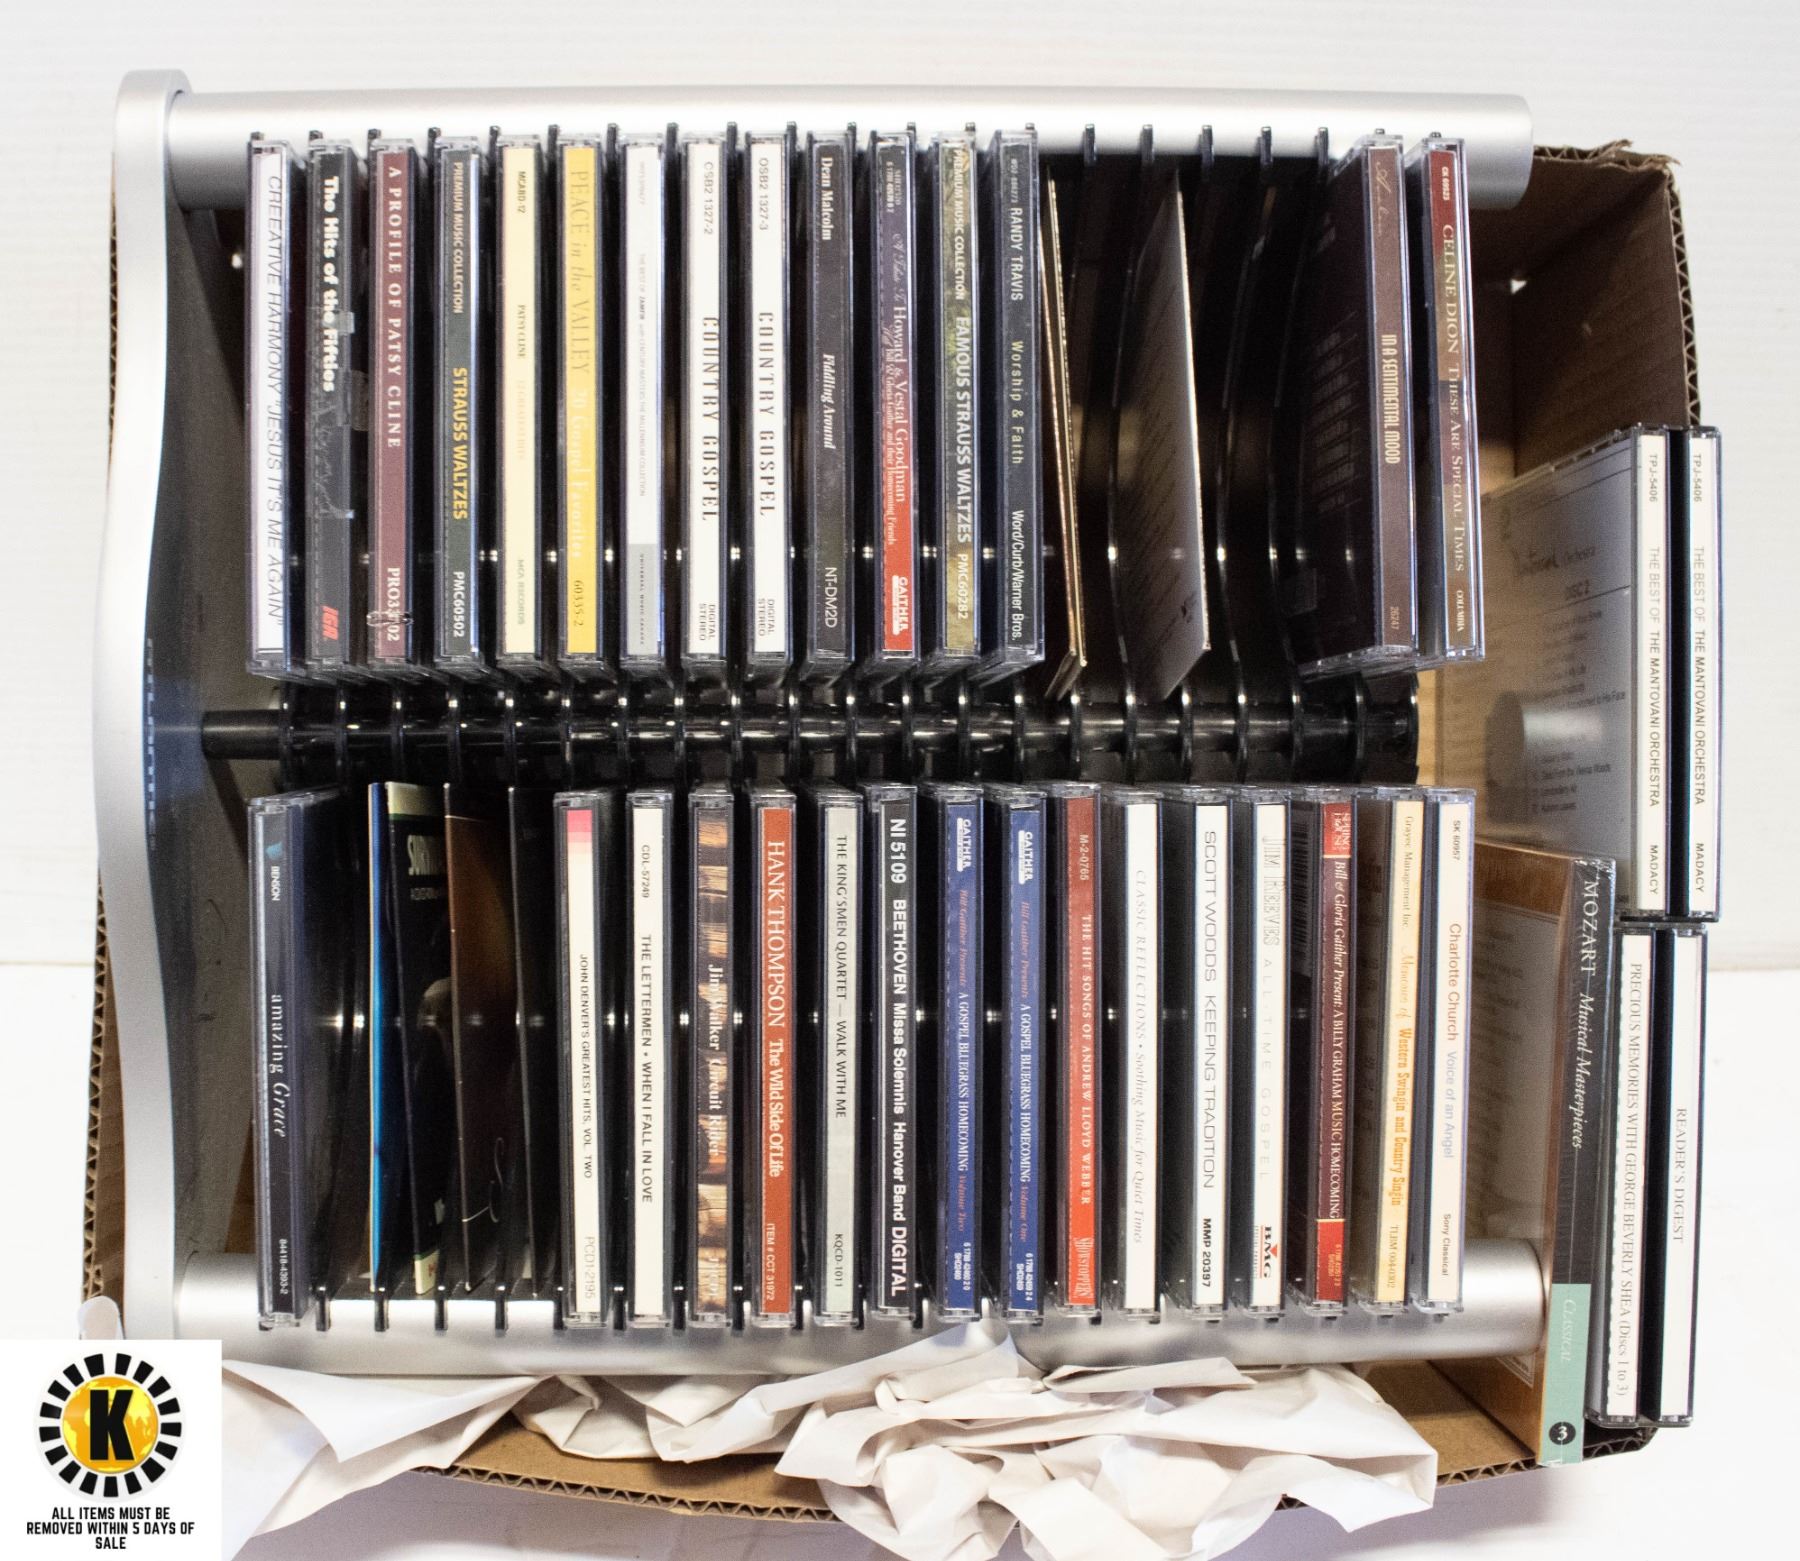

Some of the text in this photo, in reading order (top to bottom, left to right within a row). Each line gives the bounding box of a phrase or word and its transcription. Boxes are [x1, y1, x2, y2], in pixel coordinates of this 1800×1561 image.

[821, 157, 834, 240] Dean Malcolm
[954, 150, 965, 299] PREMIUM MUSIC COLLECTION
[1010, 207, 1022, 250] RANDY
[453, 162, 464, 313] PREMIUM MUSIC COLLECTION
[570, 171, 592, 374] PEACE in the VALLEY
[323, 176, 339, 391] The Hits of the Fifties
[388, 167, 401, 447] A PROFILE OF PATSY CLINE
[1010, 256, 1024, 300] TRAVIS
[1442, 224, 1459, 353] CELINE DION
[894, 306, 907, 362] Howard
[1382, 335, 1397, 346] IN
[821, 354, 836, 448] Fiddling Around
[894, 367, 904, 377] &
[894, 380, 908, 423] Vestal
[1009, 341, 1024, 464] Worship & Faith
[1383, 359, 1399, 428] SENTIMENTAL
[453, 367, 468, 519] STRAUSS WALTZES
[702, 317, 719, 521] COUNTRY GOSPEL
[758, 312, 775, 517] COUNTRY GOSPEL
[955, 317, 971, 543] FAMOUS STRAUSS WALTZES
[1385, 431, 1400, 464] MOOD
[894, 428, 909, 502] Goodman
[1649, 454, 1657, 502] TPJ-5406
[1693, 454, 1702, 502] TPJ-5406
[454, 572, 464, 637] PMC60502
[825, 567, 837, 628] NT-DM2D
[958, 554, 968, 619] PMC60282
[1012, 511, 1024, 640] Word/Curb/Warner Bros.
[1650, 547, 1659, 806] THE BEST OF THE MANTOVANI ORCHESTRA
[1694, 546, 1705, 804] THE BEST OF THE MANTOVANI ORCHESTRA
[271, 866, 280, 900] BENSON
[641, 845, 650, 898] CDL-57249
[891, 819, 906, 883] NI 5109
[1335, 861, 1346, 879] Bill
[1650, 845, 1658, 894] MADACY
[1696, 843, 1704, 892] MADACY
[767, 840, 785, 1027] HANK THOMPSON
[1205, 831, 1216, 981] SCOTT WOODS
[1334, 894, 1345, 926] Gloria
[641, 935, 651, 960] THE
[836, 836, 847, 1118] THE KING'SMEN QUARTET WALK WITH ME
[1334, 929, 1346, 965] Gaither
[1447, 923, 1461, 1041] Charlotte Church
[641, 965, 651, 1046] LETTERMEN
[893, 900, 907, 1114] BEETHOVEN Missa Solemnis
[1333, 1020, 1343, 1048] BILLY
[1569, 880, 1598, 1149] MOZART Musical Masterpieces
[270, 994, 290, 1137] amazing Grace
[642, 1063, 652, 1102] WHEN
[1080, 915, 1092, 1204] THE HIT SONGS OF ANDREW LLOYD WEBBER
[1204, 995, 1216, 1188] KEEPING TRADITION
[1332, 1051, 1342, 1099] GRAHAM
[642, 1114, 652, 1146] FALL
[769, 1038, 784, 1177] The Wild Side Of Life
[1331, 1101, 1343, 1140] MUSIC
[1442, 1051, 1456, 1158] Voice of an Angel
[642, 1150, 652, 1164] IN
[642, 1168, 652, 1203] LOVE
[893, 1122, 906, 1221] Hanover Band
[1330, 1143, 1341, 1218] HOMECOMING
[1673, 1109, 1686, 1243] READER'S DIGEST
[891, 1227, 906, 1296] DIGITAL
[1202, 1218, 1212, 1287] MMP 20397
